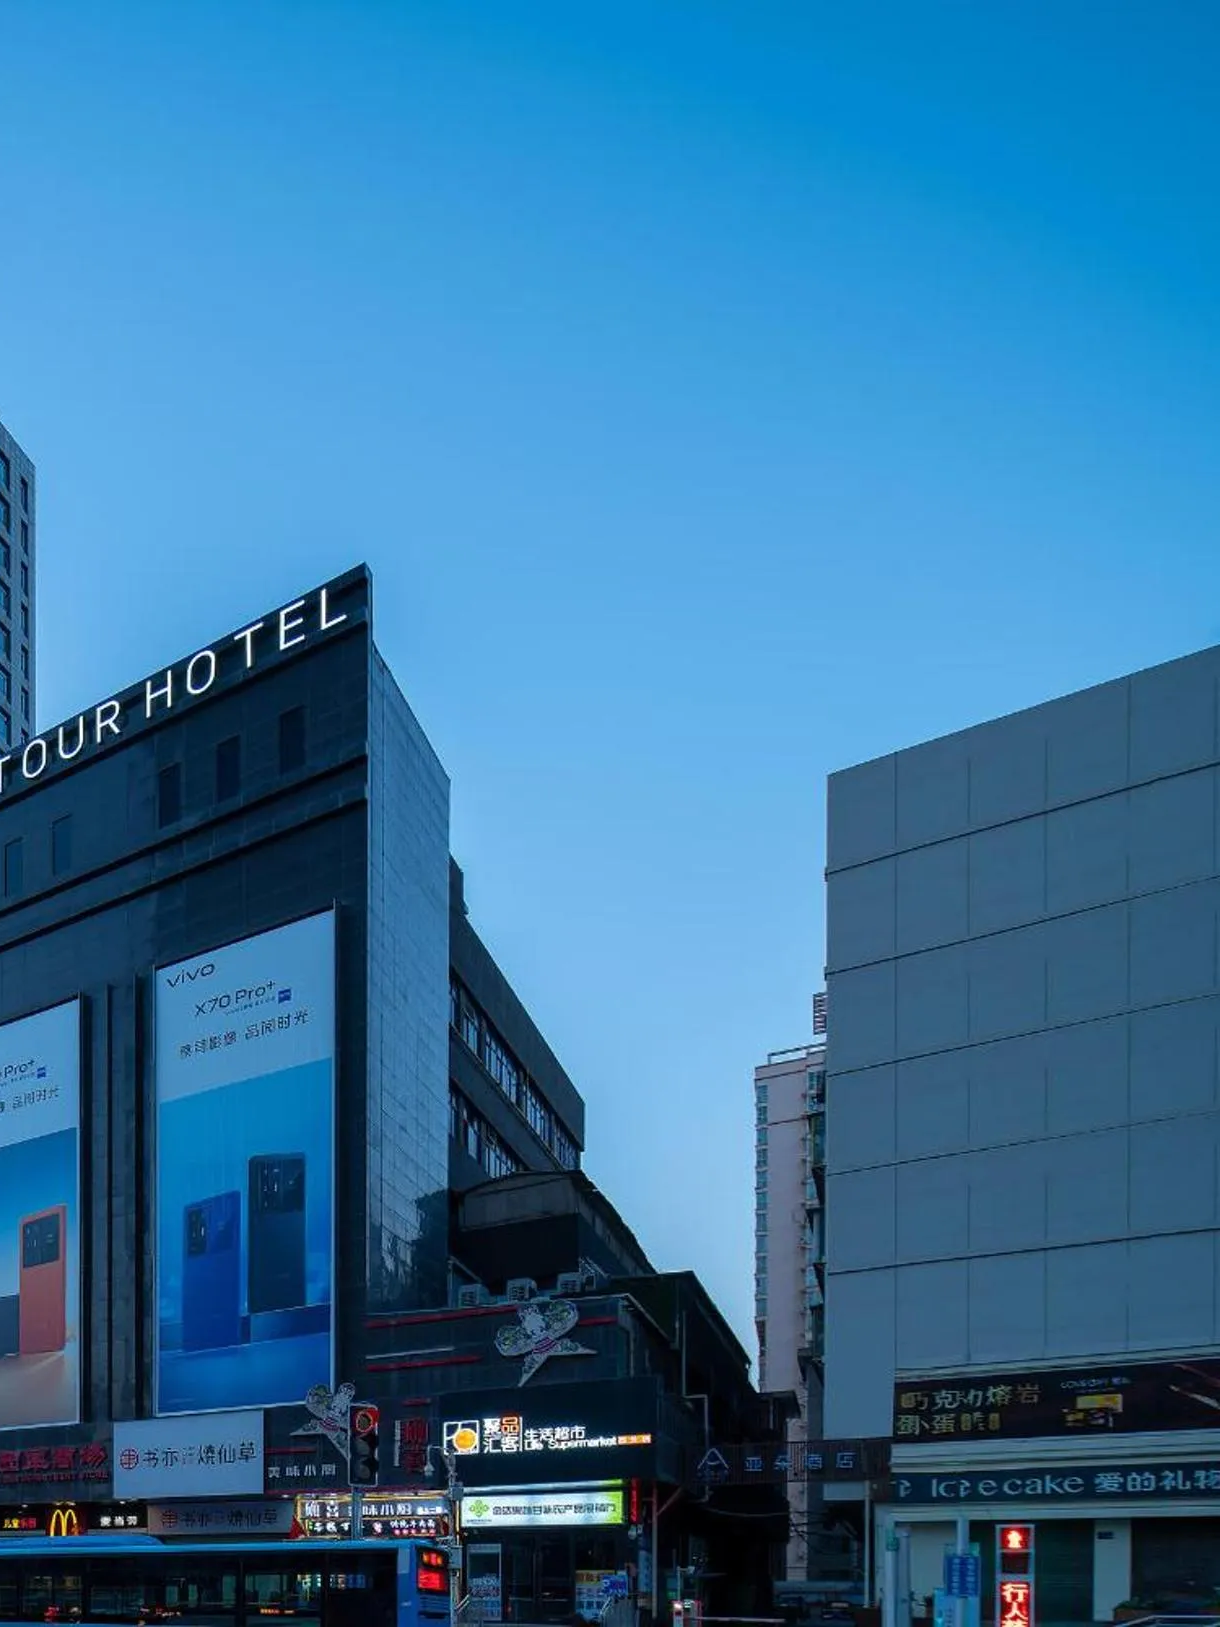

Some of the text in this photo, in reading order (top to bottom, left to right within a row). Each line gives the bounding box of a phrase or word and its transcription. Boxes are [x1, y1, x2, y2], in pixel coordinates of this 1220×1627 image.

[145, 587, 349, 718] HOTEL
[166, 963, 216, 988] vivo
[195, 980, 276, 1017] X70 Pro+
[524, 1425, 586, 1441] 生活超市
